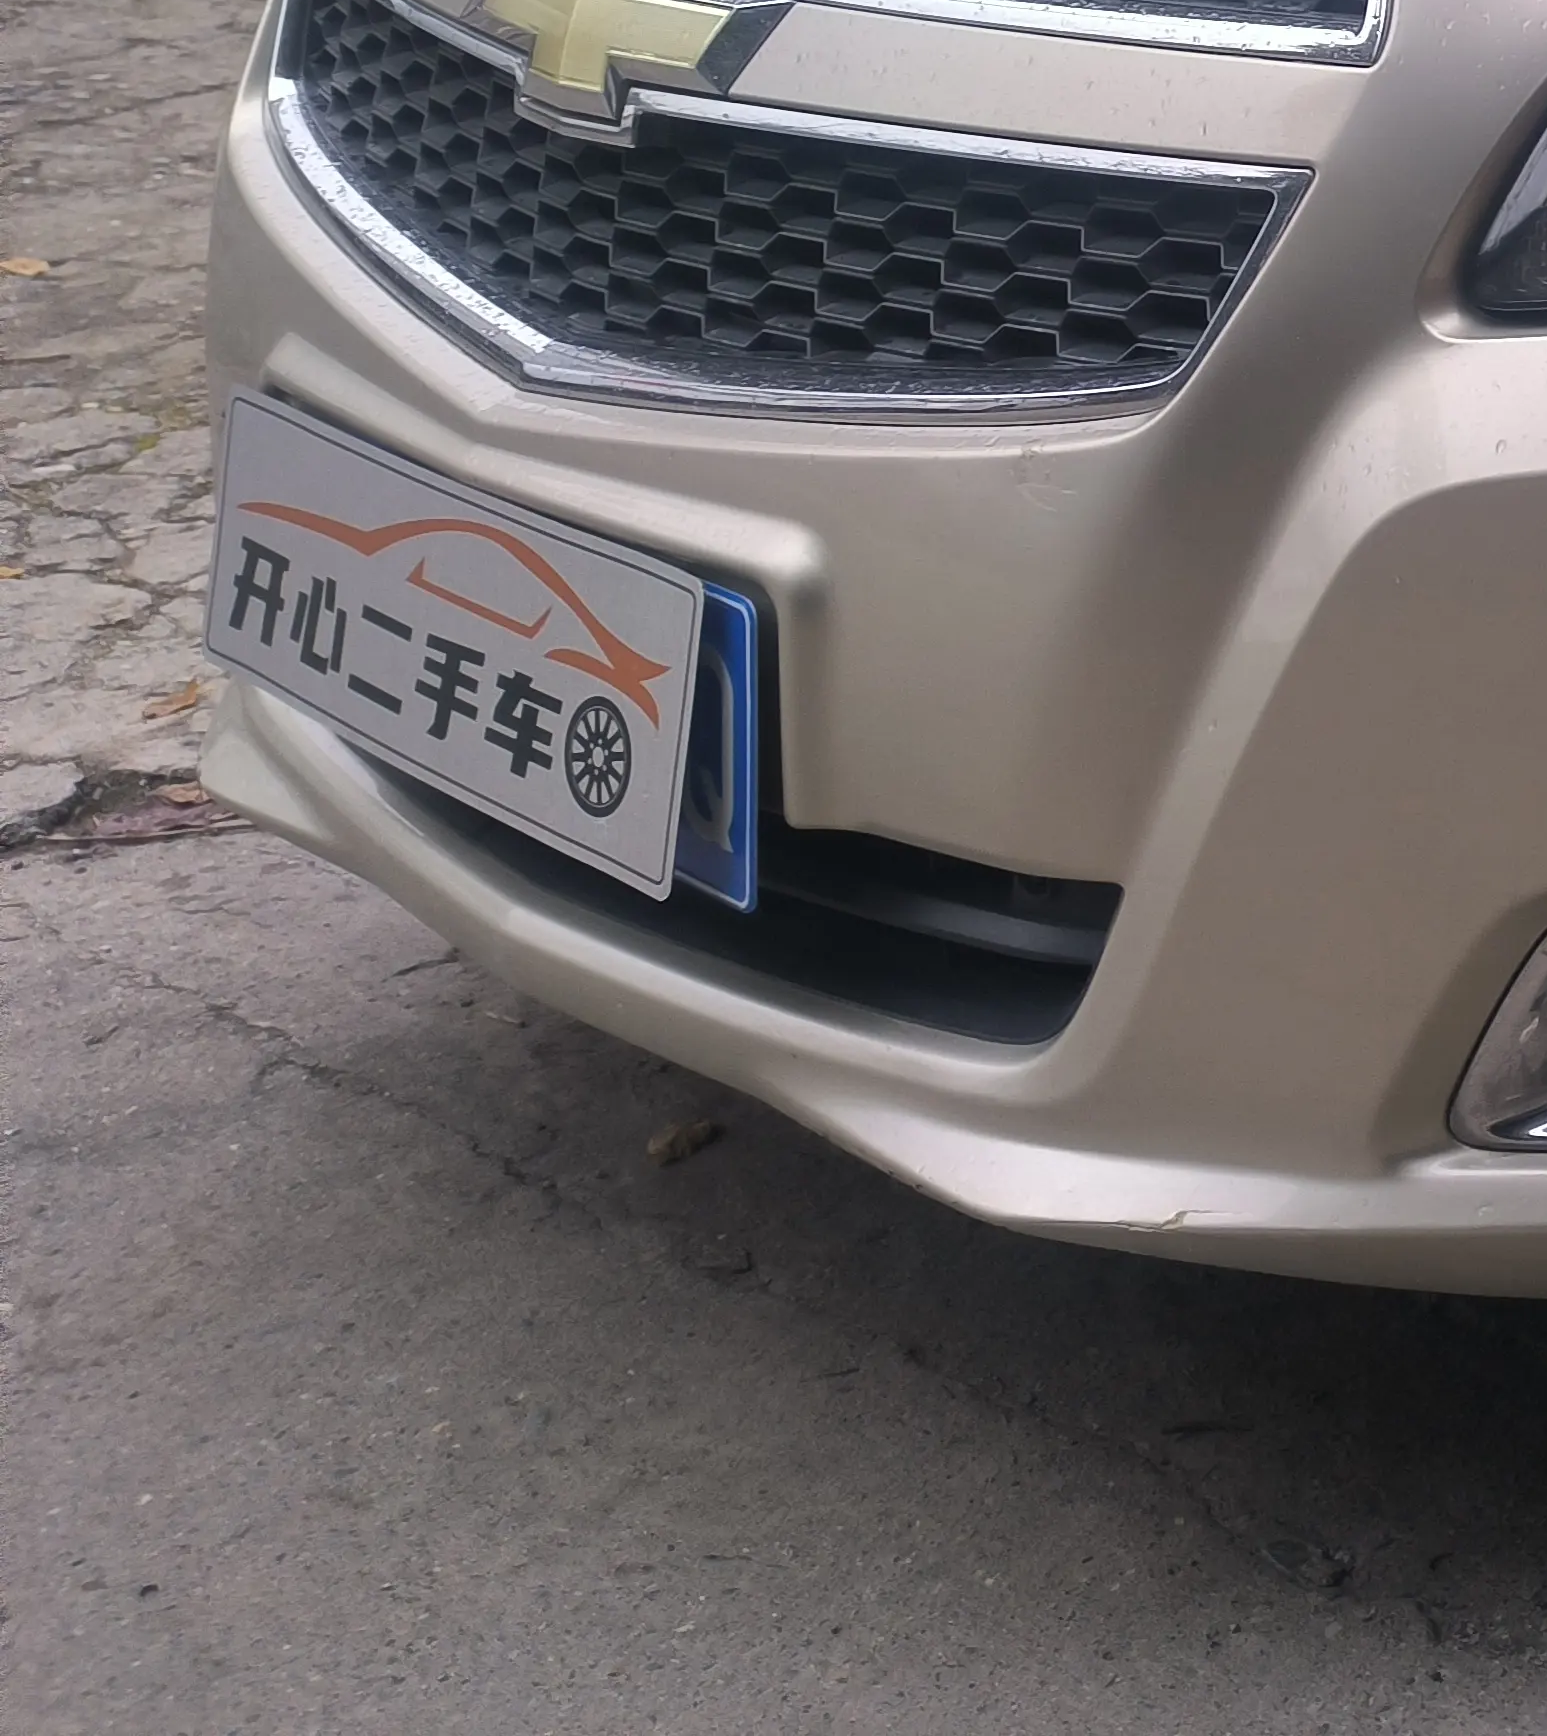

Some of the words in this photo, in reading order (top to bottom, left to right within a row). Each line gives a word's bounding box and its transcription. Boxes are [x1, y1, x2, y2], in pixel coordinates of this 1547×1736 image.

[229, 536, 563, 779] 开心二手车
